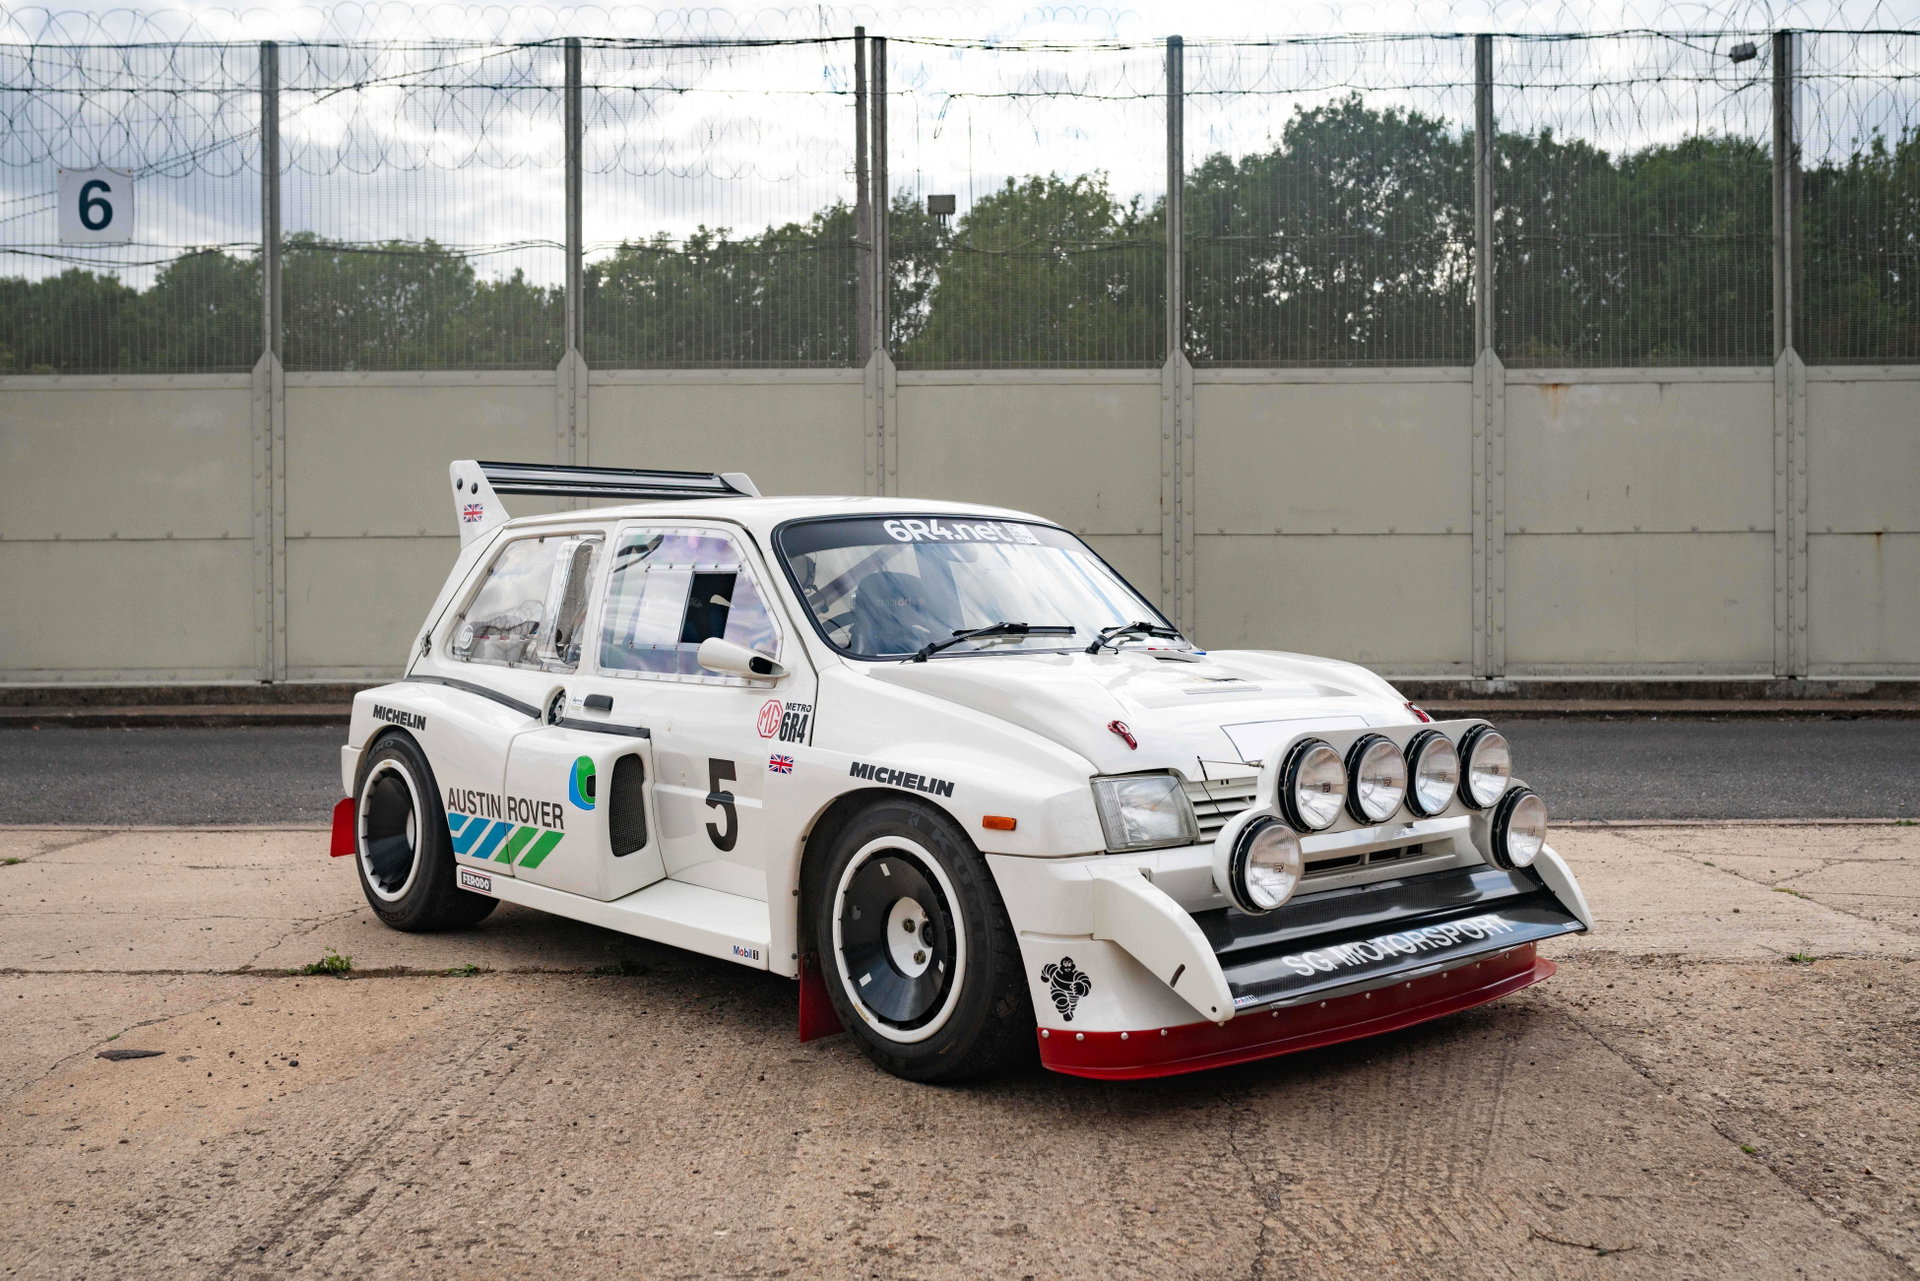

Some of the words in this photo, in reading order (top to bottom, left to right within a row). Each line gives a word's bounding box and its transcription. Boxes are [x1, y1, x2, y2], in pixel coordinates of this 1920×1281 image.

[79, 179, 113, 231] 6
[883, 519, 1013, 542] 6R4.net
[373, 704, 426, 731] MICHELIN
[785, 702, 812, 713] METRO
[779, 711, 809, 743] 6R4
[849, 761, 955, 798] MICHELIN
[447, 787, 501, 819] AUSTIN
[507, 796, 564, 830] ROVER
[705, 757, 738, 852] 5
[462, 873, 490, 891] FERODO
[1281, 949, 1338, 976] SG
[1327, 913, 1513, 967] MOTORSPORT
